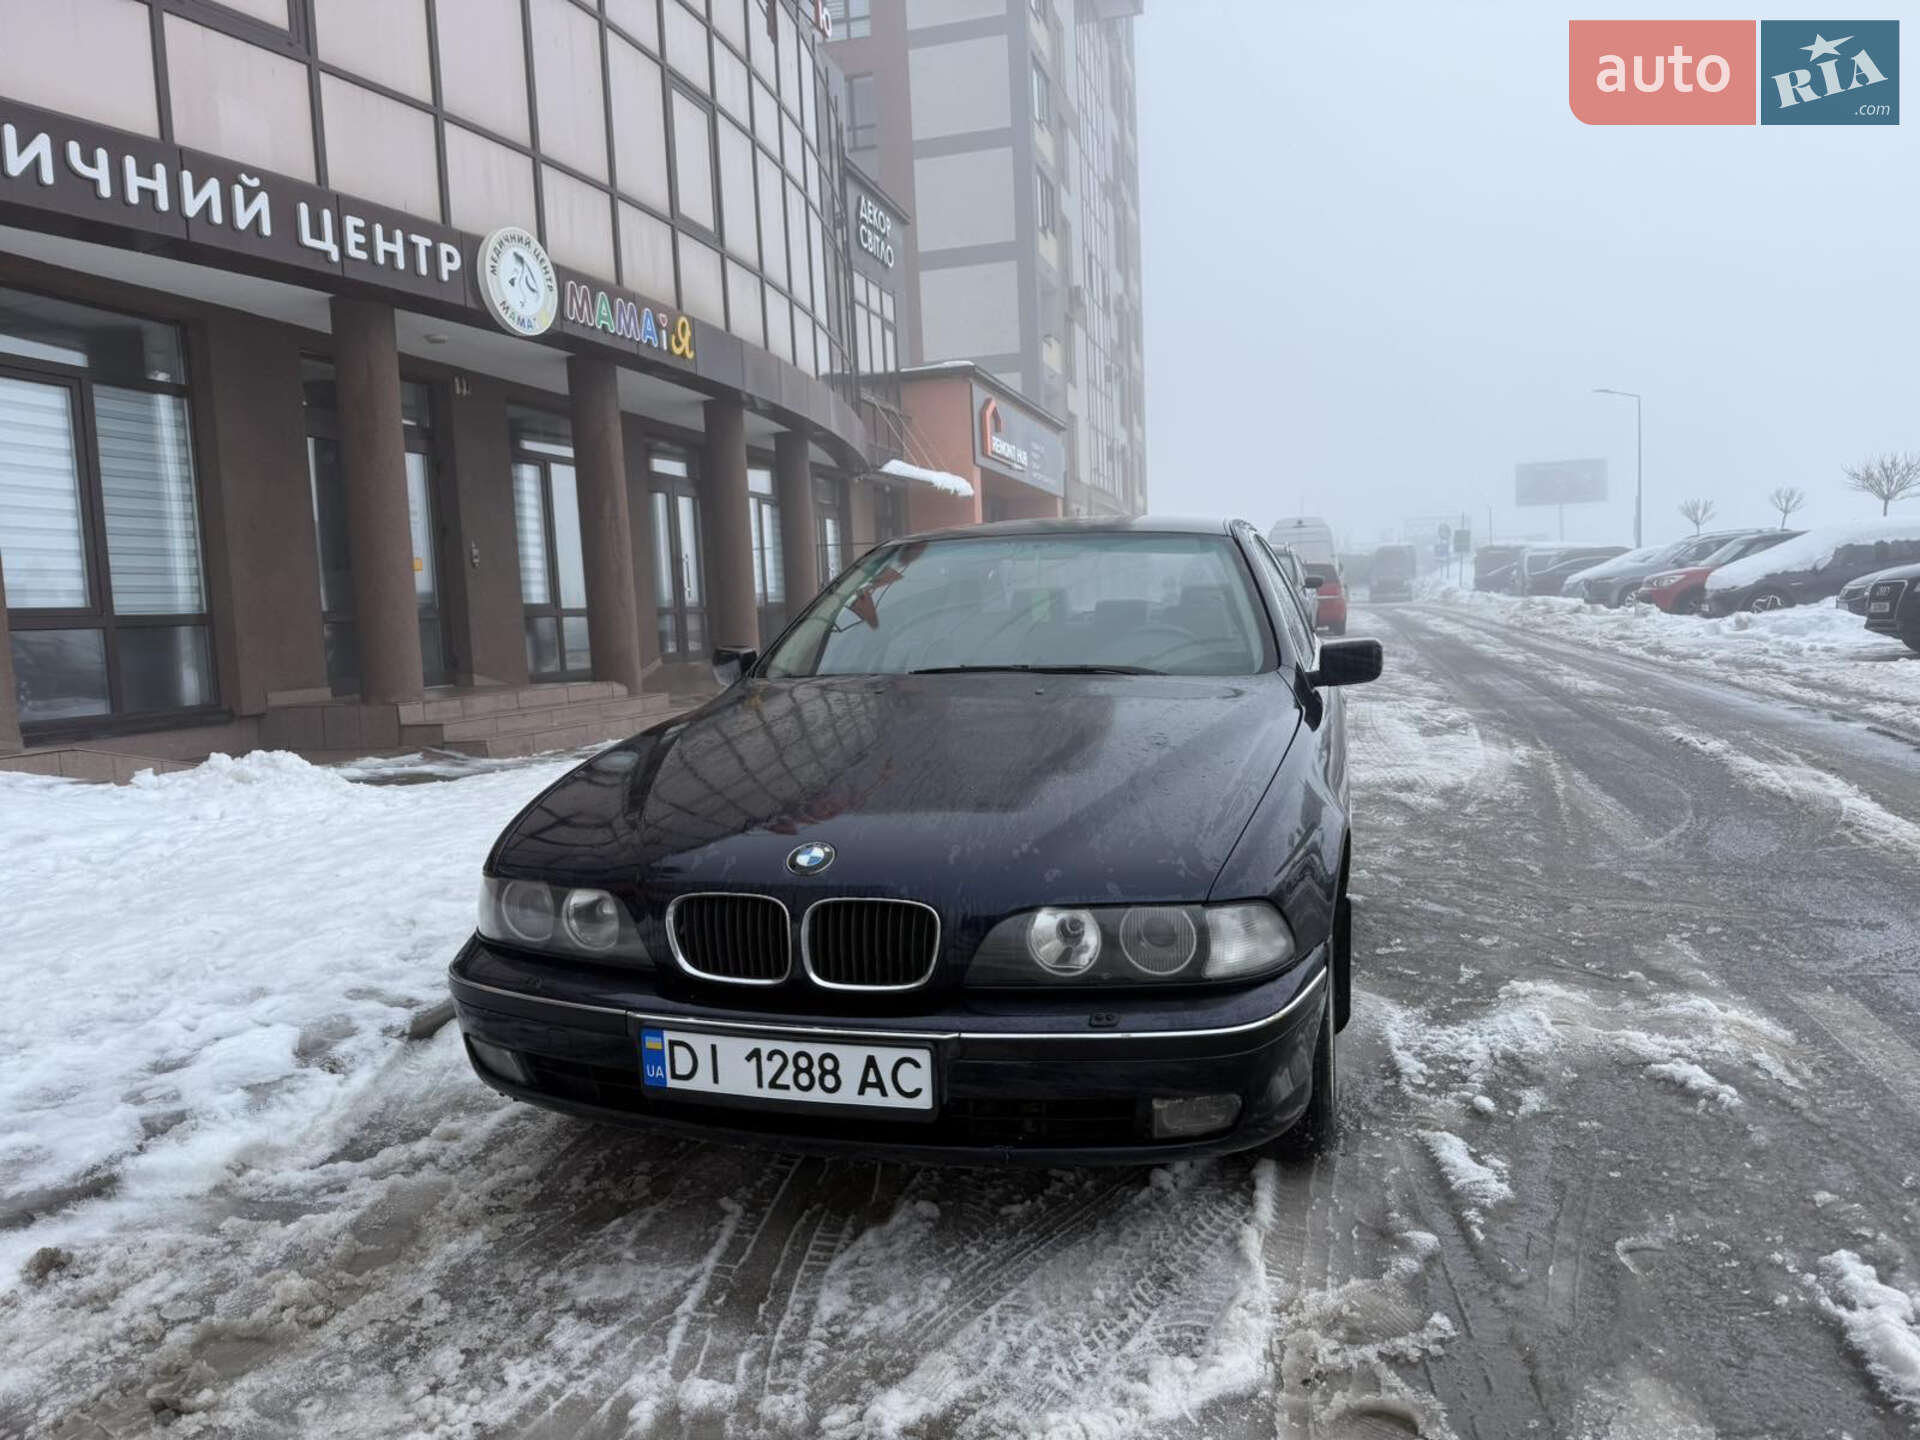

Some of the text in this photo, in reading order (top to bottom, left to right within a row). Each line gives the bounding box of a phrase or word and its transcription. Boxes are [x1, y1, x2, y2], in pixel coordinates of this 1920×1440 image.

[297, 201, 463, 282] ЦЕНТР
[859, 195, 891, 238] ДЕКОР
[490, 233, 554, 292] МЕДИЧНИЙ ЦЕНТР
[860, 224, 894, 268] СВІТЛО
[647, 1062, 664, 1079] UA
[668, 1039, 923, 1099] DI 1288 AC
